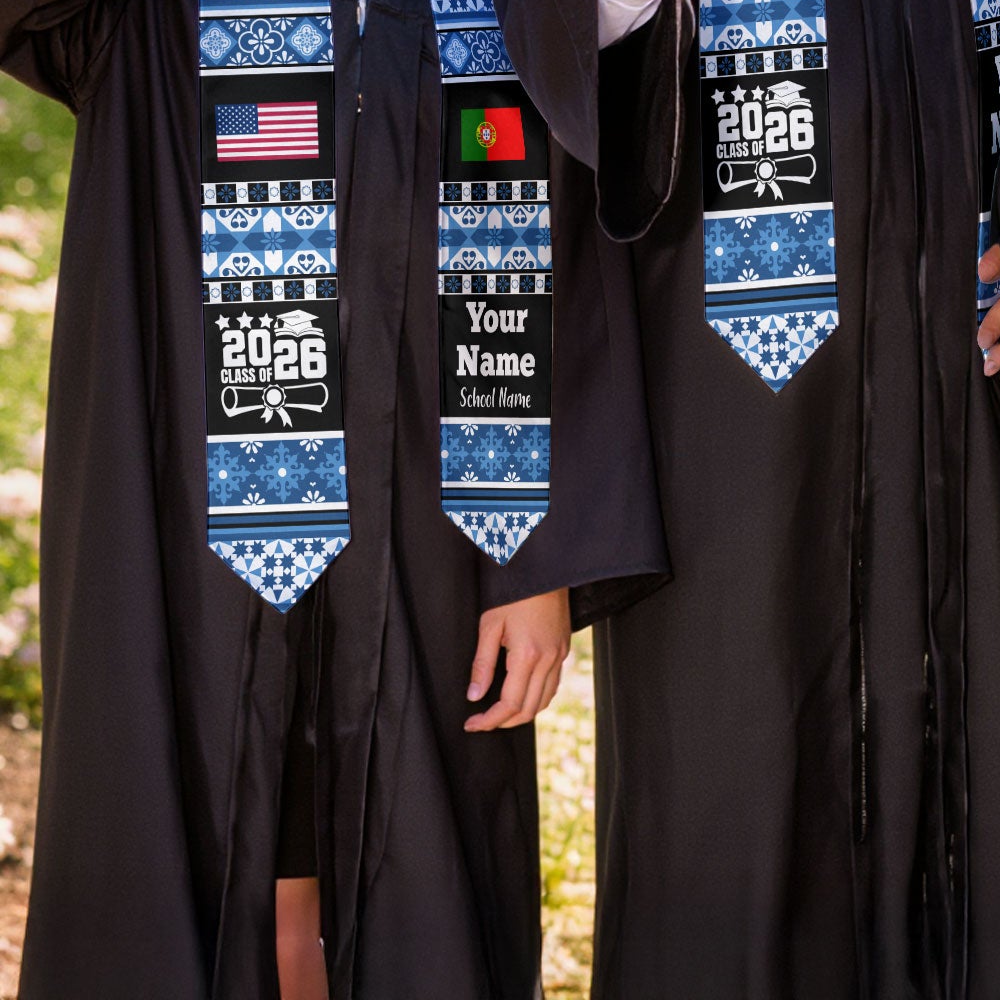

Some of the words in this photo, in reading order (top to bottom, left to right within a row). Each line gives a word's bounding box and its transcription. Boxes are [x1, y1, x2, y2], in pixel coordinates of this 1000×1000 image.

[717, 101, 815, 154] 2026
[716, 142, 749, 159] CLASS
[751, 140, 765, 156] OF
[465, 301, 529, 334] Your
[221, 328, 328, 381] 2026
[456, 344, 536, 378] Name
[220, 367, 256, 384] CLASS
[259, 367, 273, 383] OF
[460, 386, 496, 408] School
[499, 386, 532, 409] Name
